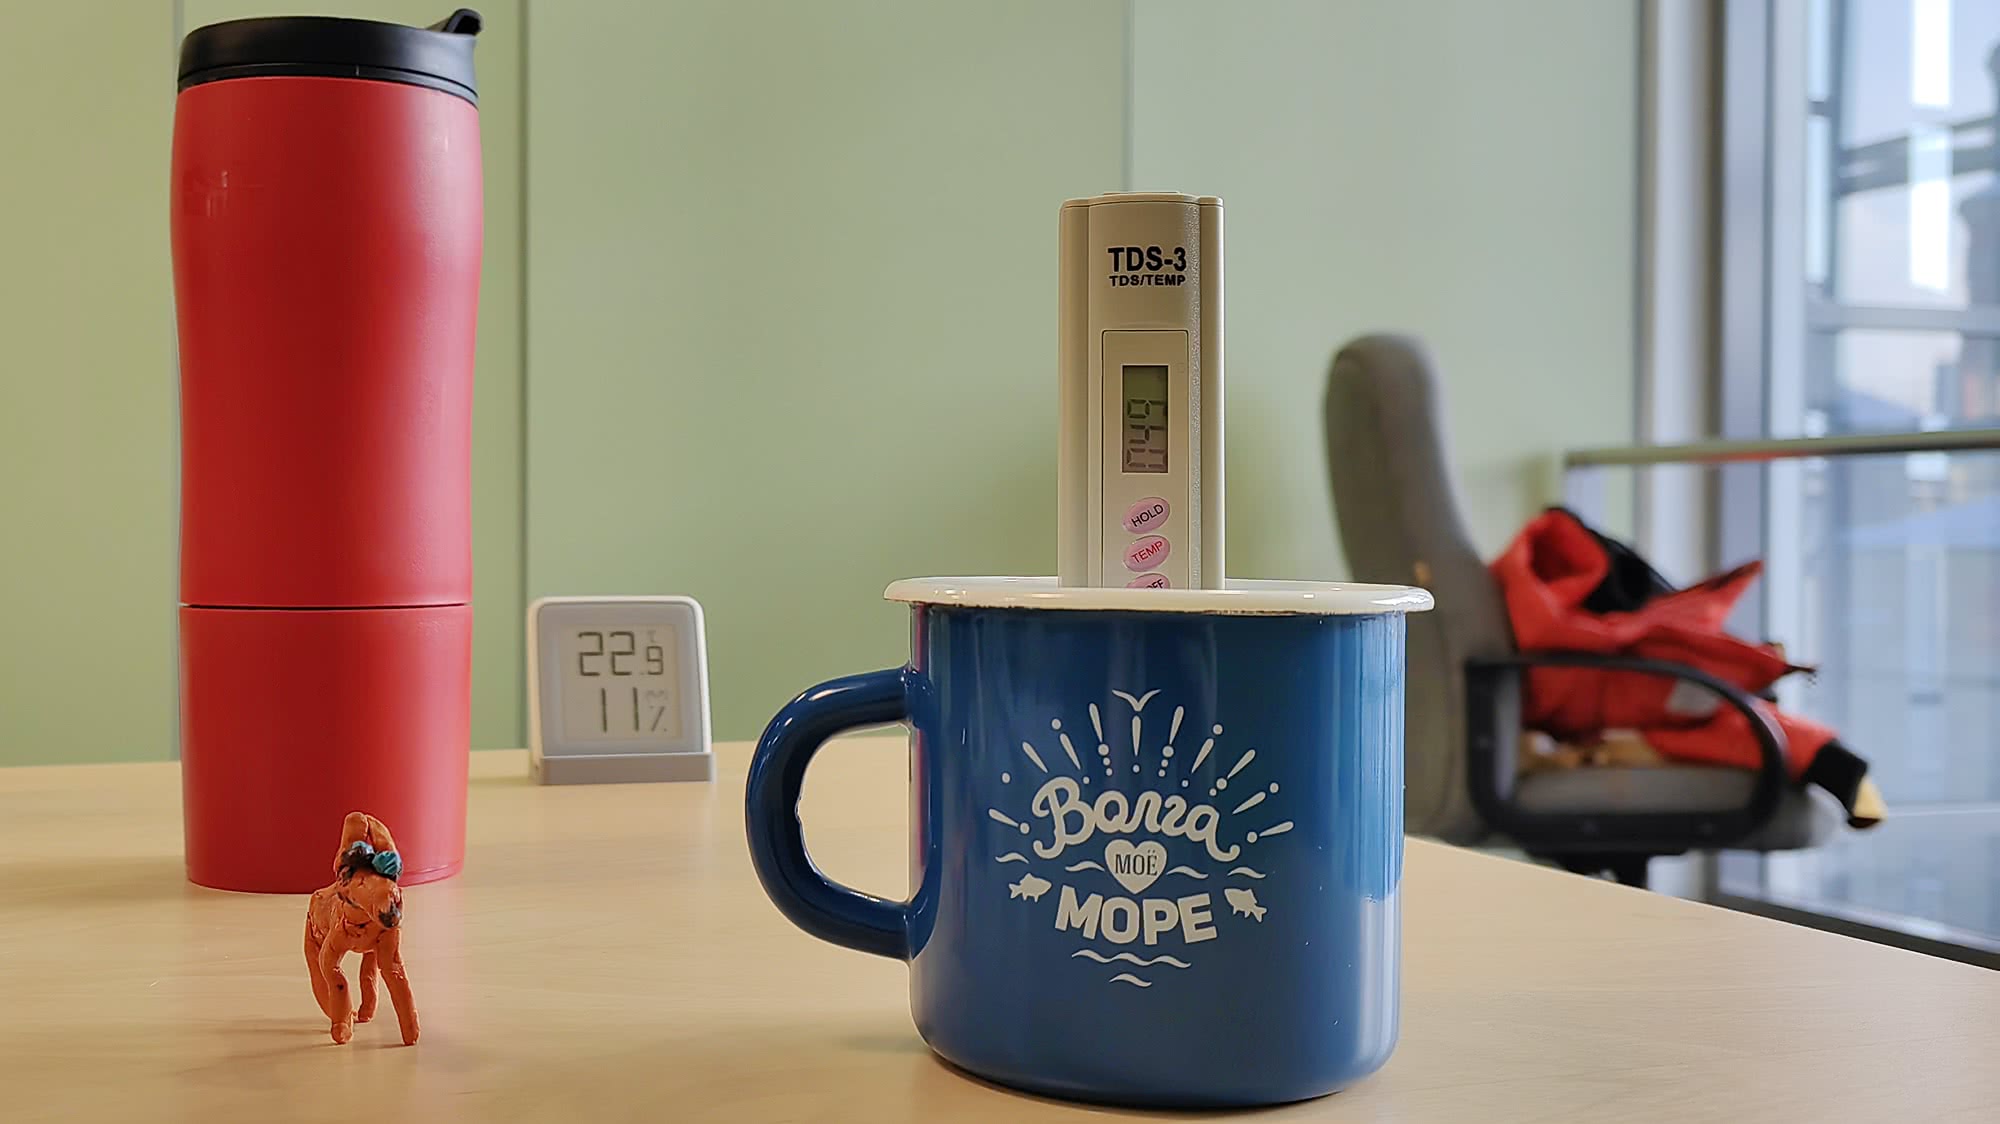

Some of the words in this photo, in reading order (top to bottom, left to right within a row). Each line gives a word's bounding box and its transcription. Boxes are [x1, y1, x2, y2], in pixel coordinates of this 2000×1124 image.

[1107, 246, 1187, 272] TDS-3
[1109, 274, 1186, 287] TDS/TEMP
[1131, 504, 1164, 527] HOLD
[1131, 541, 1163, 563] TEMP
[1032, 776, 1241, 860] Волга
[1115, 850, 1158, 876] МОЁ
[1055, 885, 1217, 945] МОРЕ
